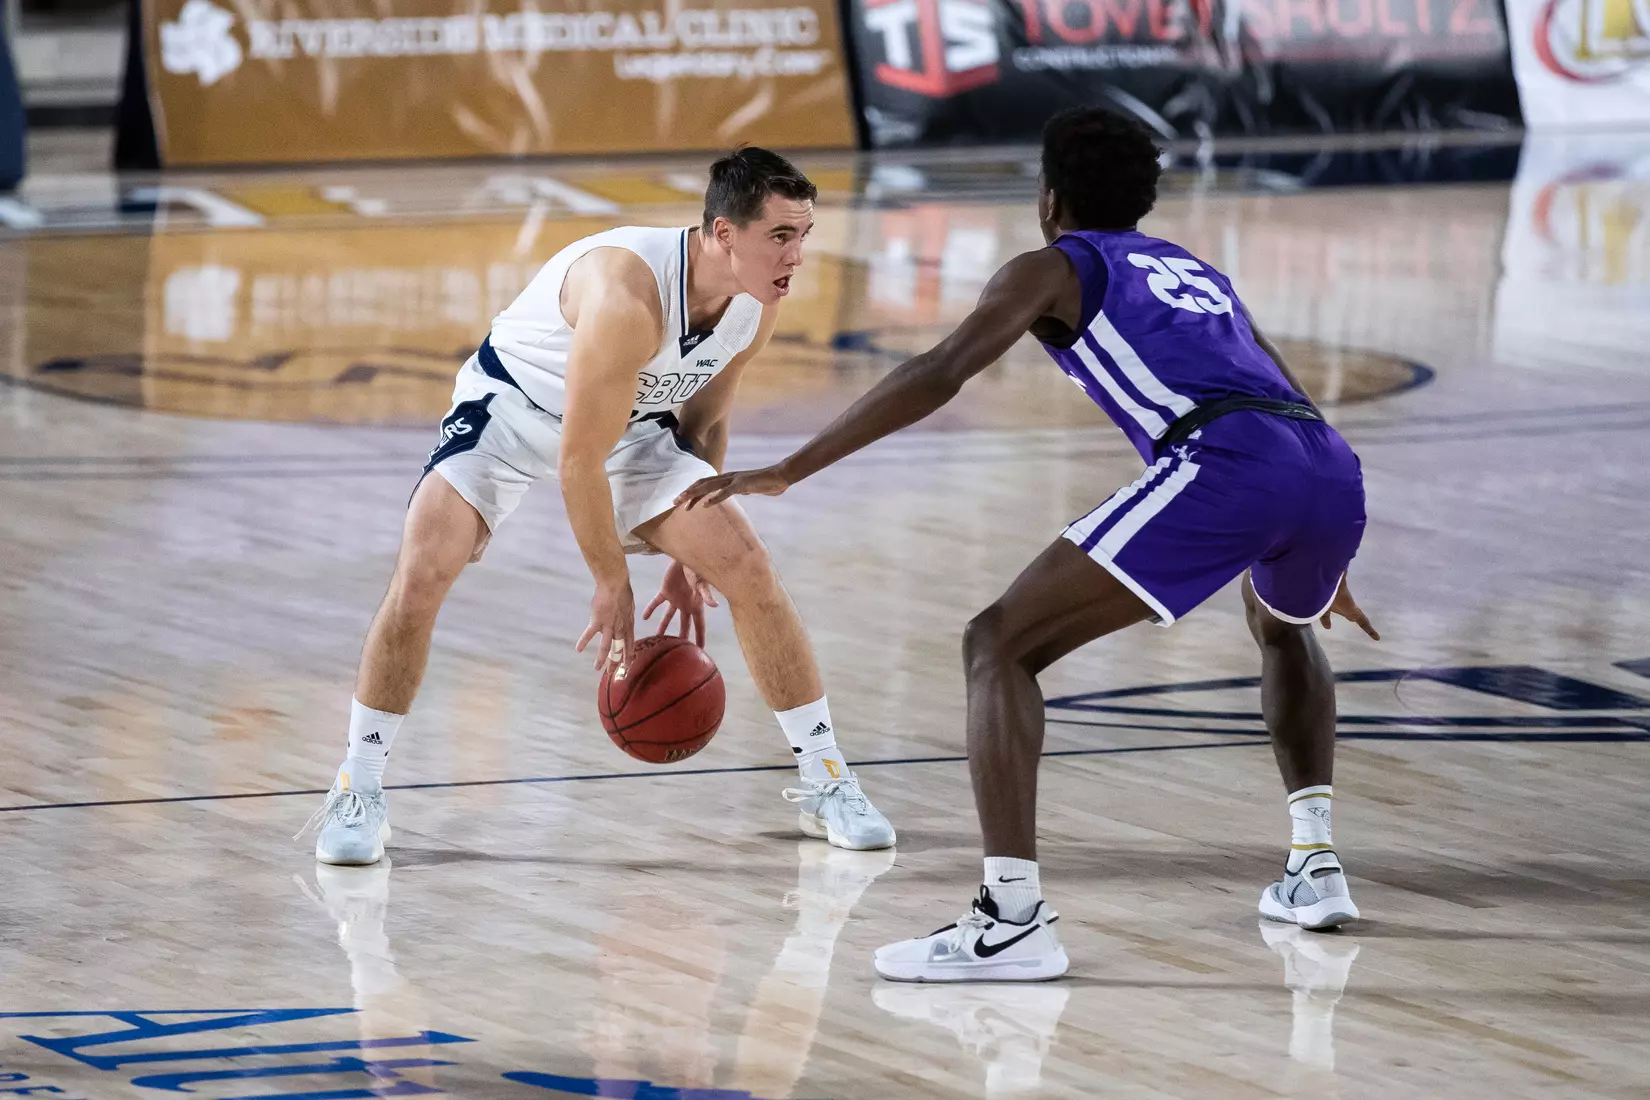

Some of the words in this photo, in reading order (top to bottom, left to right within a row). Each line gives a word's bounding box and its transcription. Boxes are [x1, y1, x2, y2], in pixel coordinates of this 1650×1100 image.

[249, 15, 478, 57] RIVERSIDE
[484, 9, 674, 51] MEDICAL
[676, 7, 820, 47] CLINIC
[1127, 252, 1234, 318] 25
[695, 359, 718, 368] WAC
[361, 736, 383, 745] adidas
